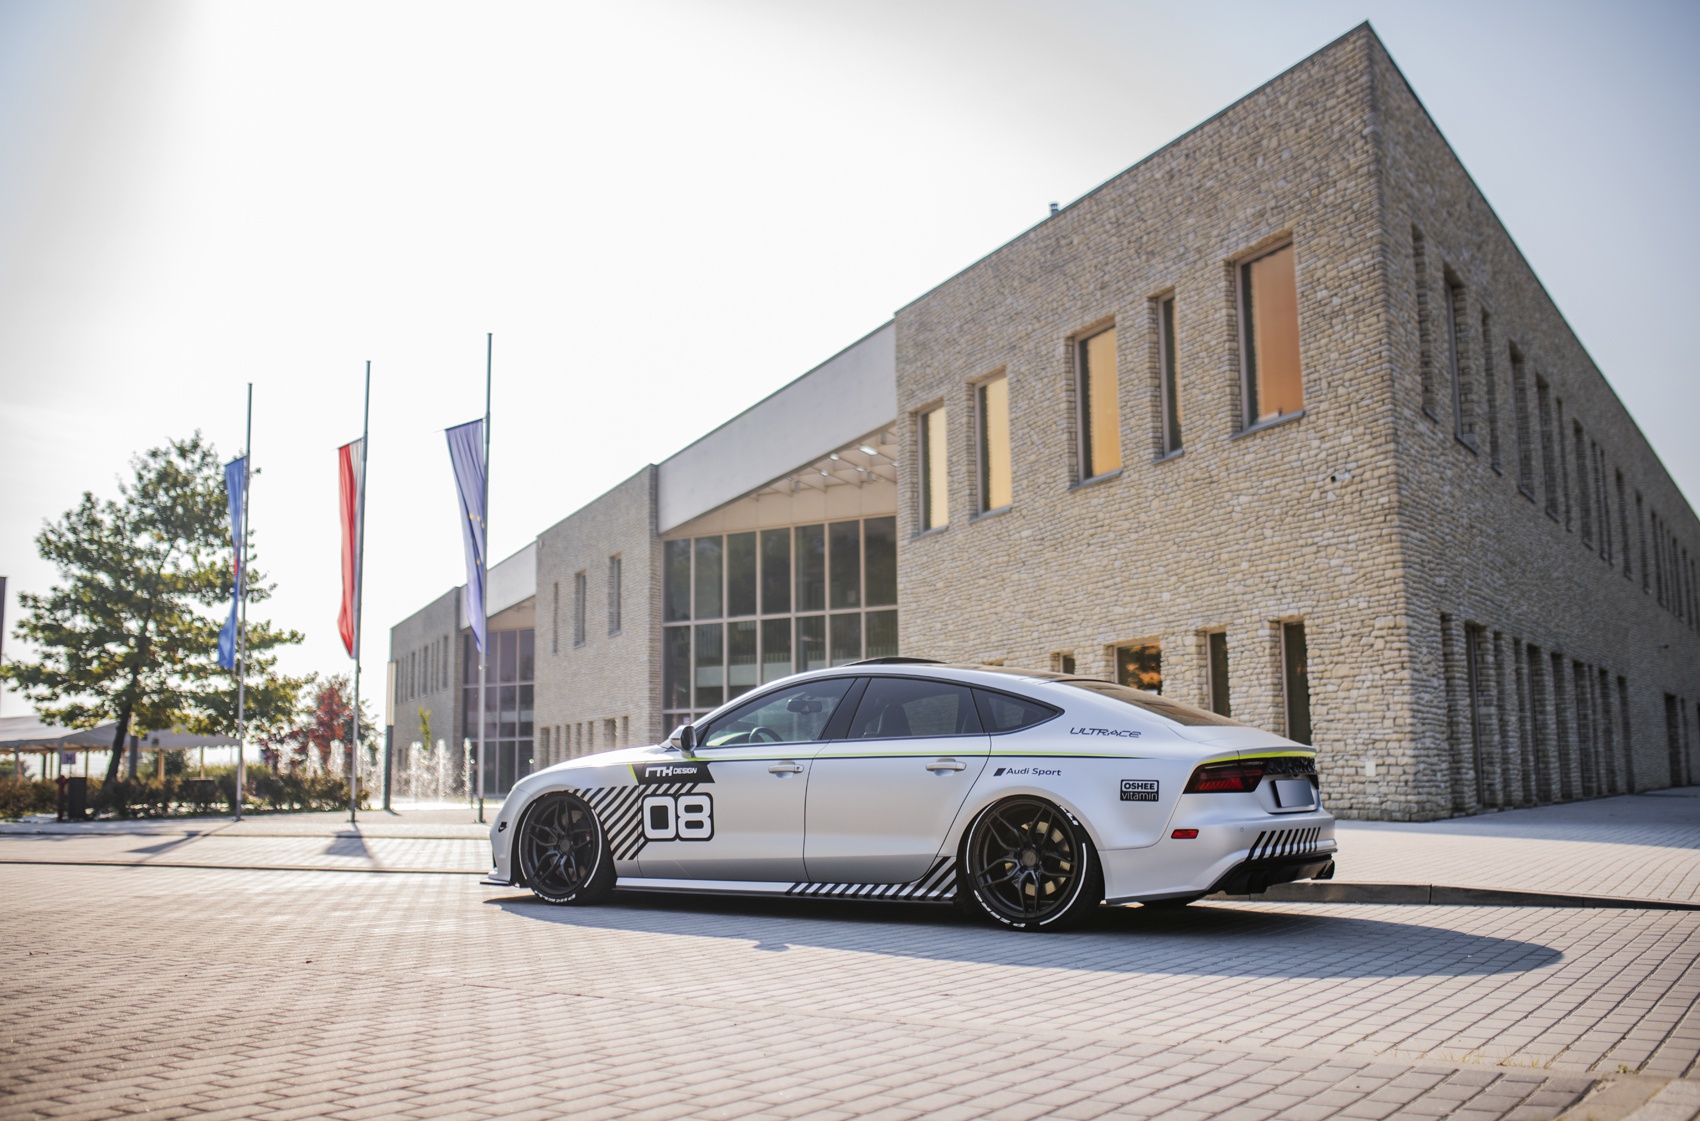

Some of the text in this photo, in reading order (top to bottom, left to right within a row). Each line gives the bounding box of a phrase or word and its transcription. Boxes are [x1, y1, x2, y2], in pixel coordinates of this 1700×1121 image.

[1070, 727, 1141, 738] ULTRACE
[1032, 767, 1062, 776] Sport
[1124, 782, 1155, 790] OSHEE
[1121, 791, 1158, 800] vitamin
[642, 792, 714, 841] 08
